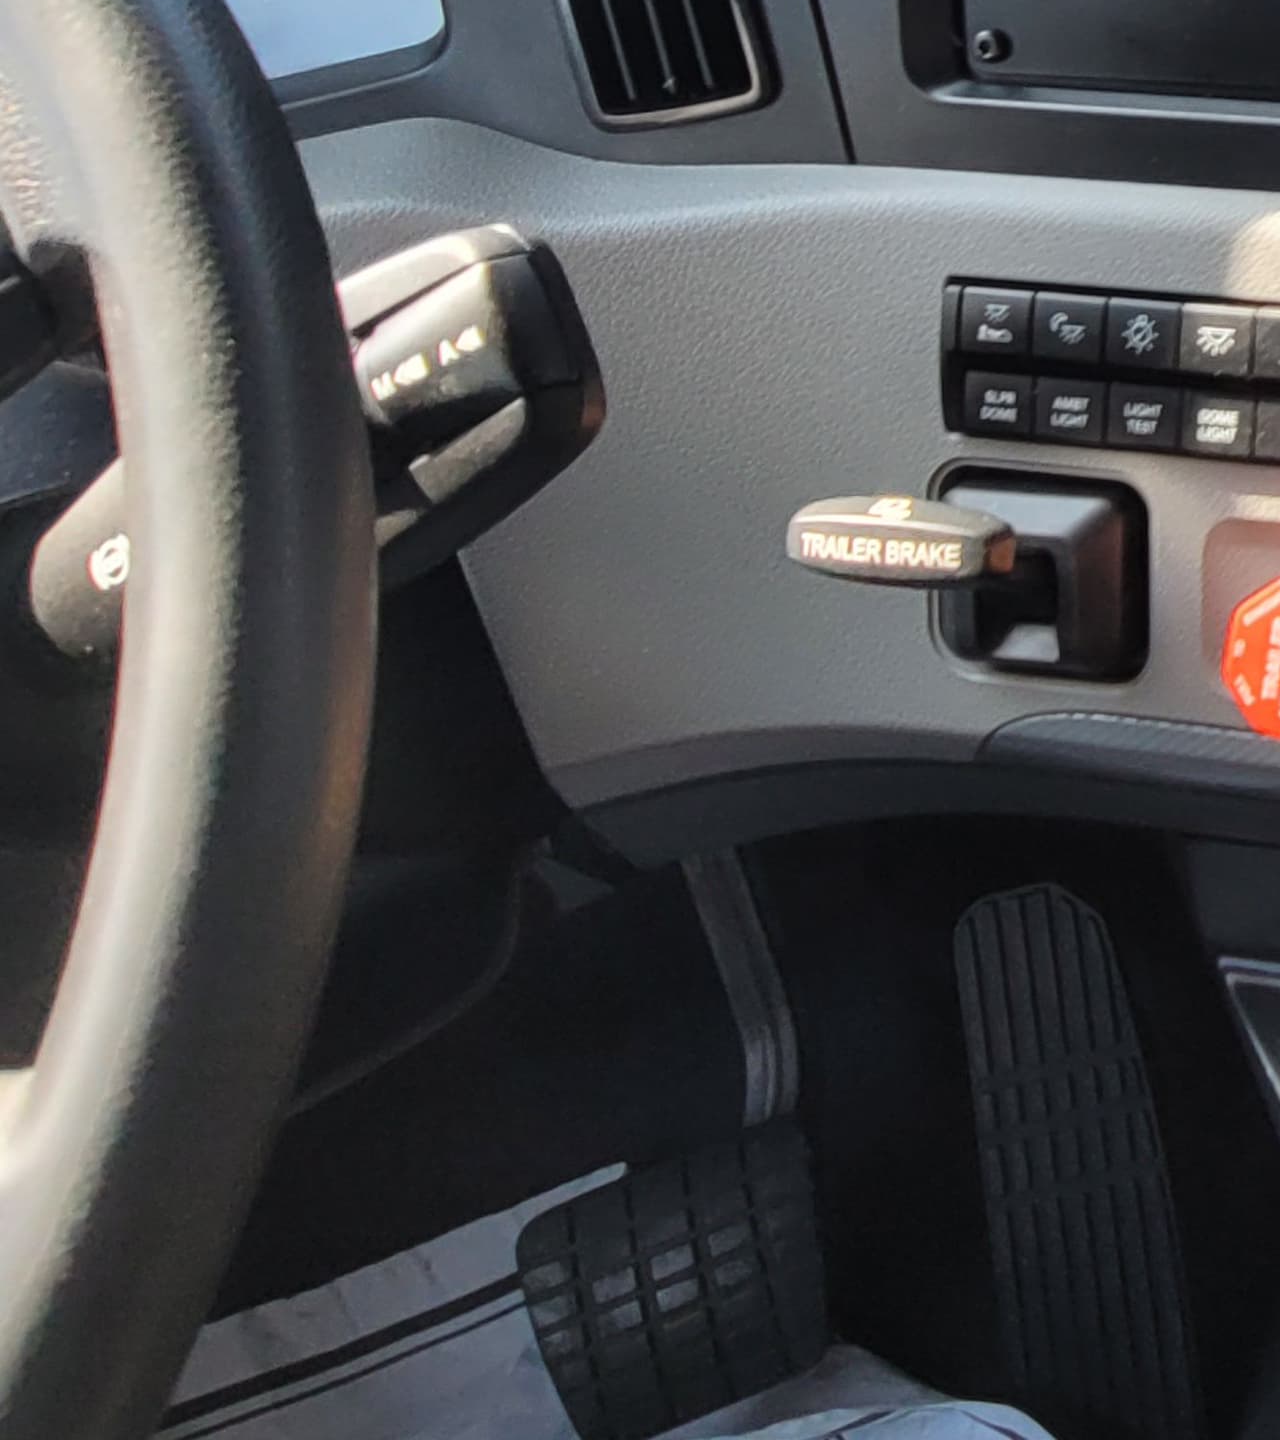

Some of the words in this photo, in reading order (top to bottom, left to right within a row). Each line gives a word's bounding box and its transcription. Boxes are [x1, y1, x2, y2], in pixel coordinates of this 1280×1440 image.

[1123, 402, 1163, 418] LIGHT
[1196, 408, 1240, 427] DOME
[1050, 412, 1089, 429] LIGHT
[1126, 418, 1159, 436] TEST
[1195, 425, 1238, 445] LIGHT
[800, 531, 882, 564] TRAILER
[885, 540, 963, 570] BRAKE
